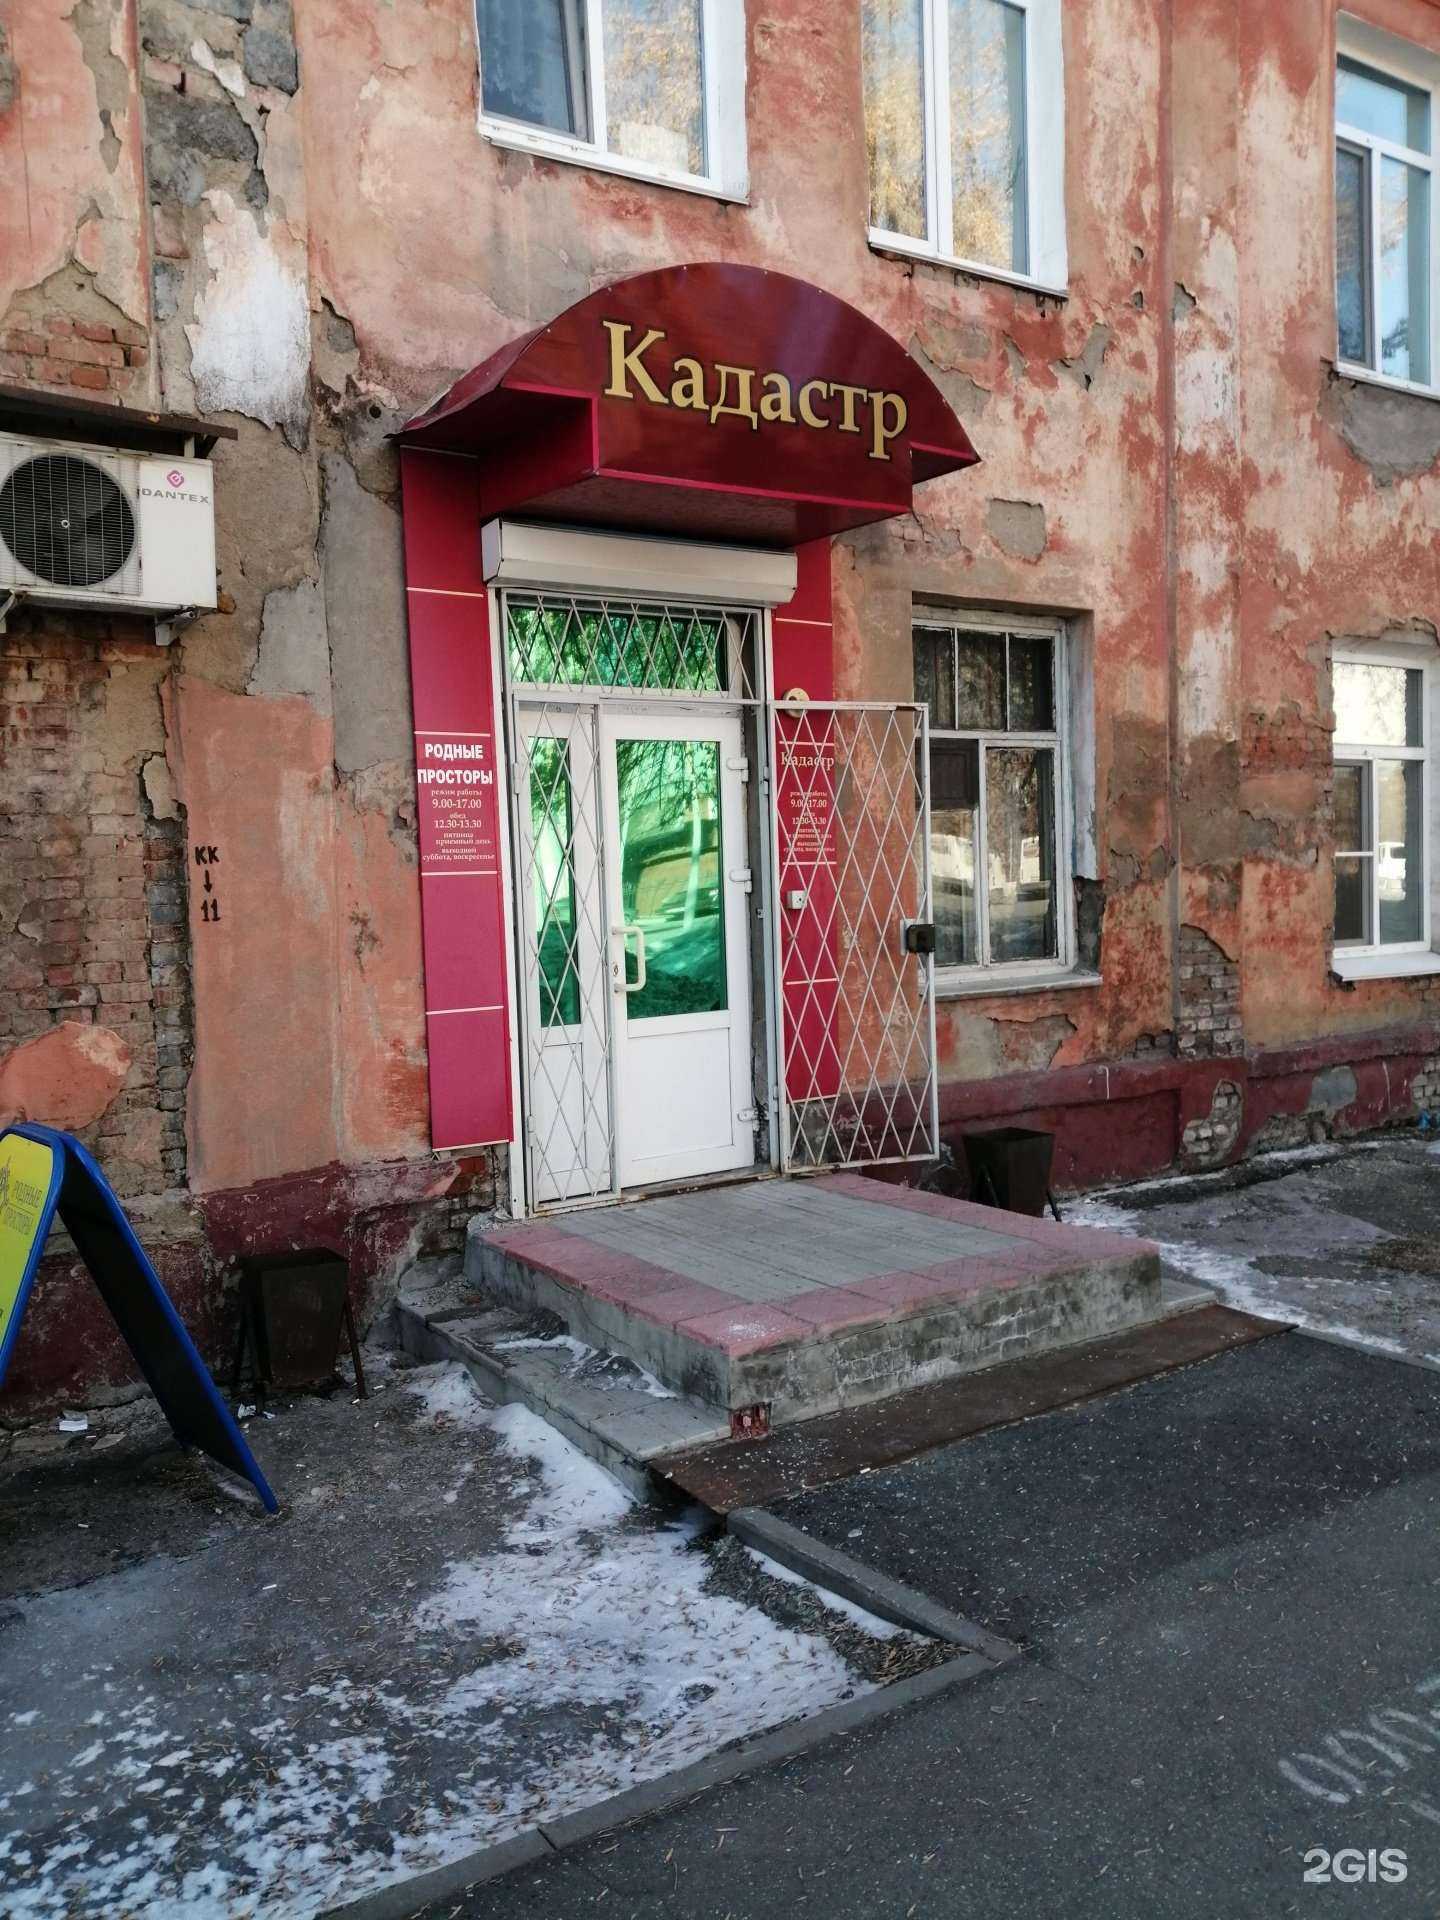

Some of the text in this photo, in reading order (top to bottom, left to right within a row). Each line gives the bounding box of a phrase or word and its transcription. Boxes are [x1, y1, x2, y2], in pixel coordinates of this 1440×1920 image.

[602, 320, 908, 461] Кадастр
[141, 487, 209, 504] DANTEX
[424, 743, 484, 760] РОДНЫЕ
[781, 752, 835, 771] Кадастр
[417, 769, 493, 785] ПРОСТОРЫ
[431, 788, 483, 797] режим работы
[432, 798, 482, 809] 9.00-17.00
[790, 799, 827, 808] 9.0017.00
[434, 819, 482, 829] 12.30-13.30
[792, 817, 827, 825] 1230-3.30
[201, 898, 221, 922] 11
